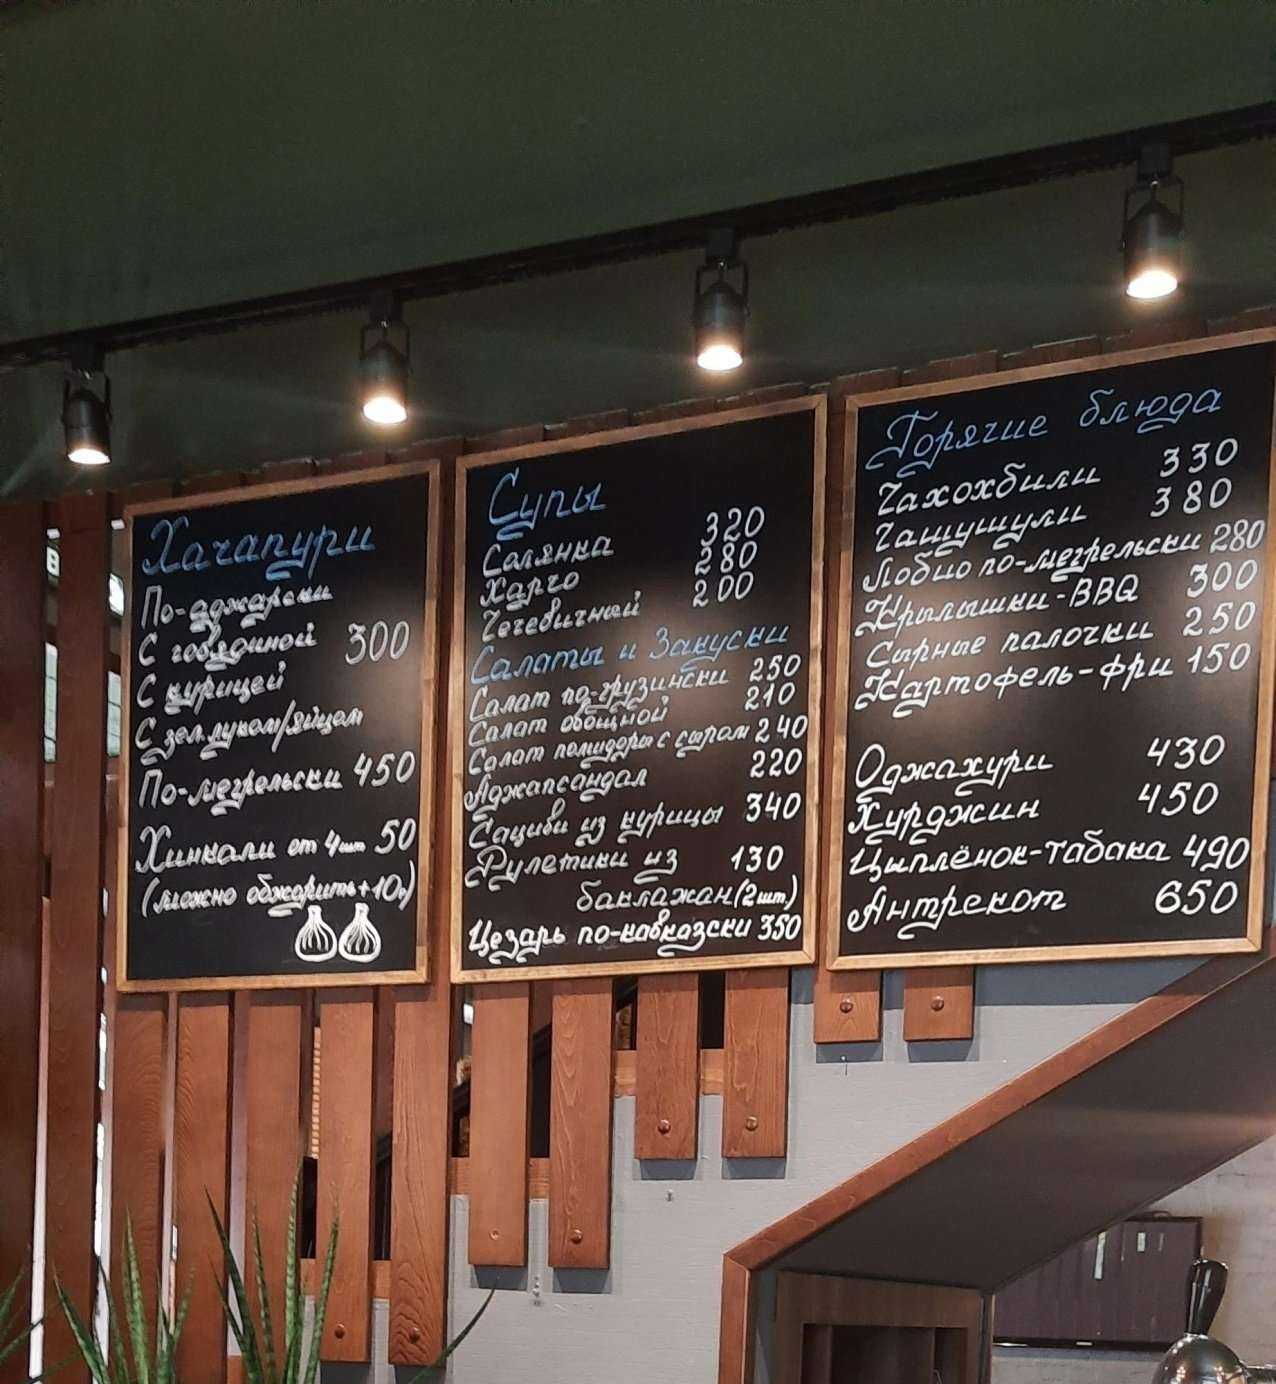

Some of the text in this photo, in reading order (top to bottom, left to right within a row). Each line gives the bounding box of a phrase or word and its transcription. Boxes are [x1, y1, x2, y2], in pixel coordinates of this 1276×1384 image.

[865, 388, 1223, 477] Горячие блюда
[489, 467, 606, 541] Супы
[877, 437, 1238, 516] Чахохбили 330
[142, 516, 375, 581] Хачапури
[701, 506, 765, 547] 320
[875, 477, 1232, 558] Чашушули 380
[480, 540, 758, 611] Харчо 280
[862, 519, 1266, 593] Лобио по-мегрельски 280
[1187, 558, 1259, 598] 300
[692, 571, 754, 608] 200
[139, 632, 158, 666] С
[345, 620, 410, 665] 300
[471, 625, 789, 684] Салаты и Закуски
[866, 601, 1256, 670] Сырные палочки 250
[137, 660, 286, 716] С курицей
[469, 655, 801, 722] Салат по-грузински 250
[854, 642, 1252, 718] Картофель-фри 150
[135, 717, 157, 749] С
[468, 682, 796, 747] Салат овощной 210
[468, 746, 545, 775] Салат
[553, 731, 654, 769] помидоры
[674, 725, 750, 758] сыром
[754, 714, 807, 744] 240
[139, 751, 415, 816] По-мегрельски 450
[463, 748, 802, 822] Аджапсандал 220
[855, 734, 1225, 803] Оджахури 430
[468, 792, 801, 850] Сациви из курицы 340
[848, 782, 1219, 845] Хурджин 450
[135, 825, 276, 873] Хинкали
[288, 838, 317, 857] от
[374, 817, 417, 855] 50
[464, 845, 784, 892] Рулетики из 130
[849, 829, 1251, 883] Цыплёнок-табака 490
[576, 880, 732, 912] баклажан
[847, 880, 1238, 940] Антрекот 650
[468, 909, 801, 965] Цезарь по-кавказски 350
